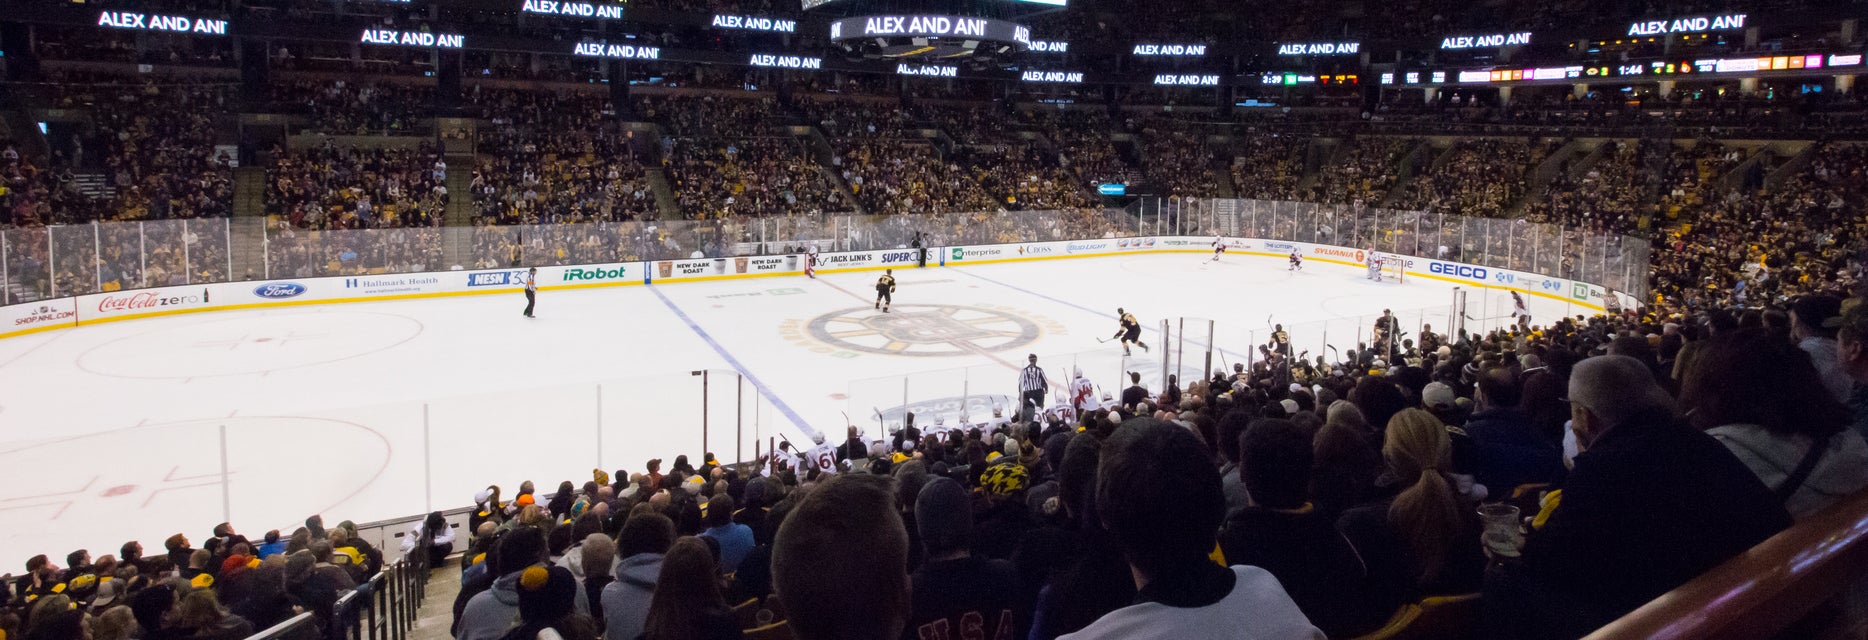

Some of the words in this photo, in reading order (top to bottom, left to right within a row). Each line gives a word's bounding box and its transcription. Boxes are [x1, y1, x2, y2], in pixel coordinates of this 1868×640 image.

[523, 0, 558, 13] ALEX
[562, 2, 593, 16] AND
[596, 5, 620, 18] ANI
[98, 11, 146, 28] ALEX
[149, 15, 190, 31] AND
[194, 18, 225, 34] ANI
[712, 15, 742, 28] ALEX
[744, 18, 772, 30] AND
[774, 20, 794, 32] ANI
[865, 17, 904, 34] ALEX
[909, 17, 950, 33] AND
[954, 18, 984, 36] ANI
[1628, 20, 1668, 36] ALEX
[1670, 18, 1708, 32] AND
[1711, 15, 1744, 29] ANI
[362, 30, 398, 44] ALEX
[401, 32, 434, 46] AND
[437, 34, 462, 48] ANI
[1014, 25, 1029, 44] ALE
[1441, 36, 1473, 49] ALEX
[1476, 34, 1504, 47] AND
[1506, 33, 1530, 45] ANI
[575, 43, 605, 56] ALEX
[607, 45, 635, 57] AND
[637, 47, 658, 59] ANI
[1049, 42, 1066, 52] ANI
[1133, 45, 1159, 55] ALEX
[1160, 45, 1184, 55] AND
[1186, 45, 1204, 55] ANI
[1279, 44, 1306, 54] ALEX
[1308, 43, 1334, 54] AND
[1336, 43, 1358, 53] ANI
[750, 54, 776, 66] ALEX
[778, 56, 800, 68] AND
[802, 58, 820, 69] ANI
[920, 65, 940, 75] AND
[941, 66, 956, 76] ANI
[1022, 71, 1043, 81] ALEX
[1045, 72, 1065, 81] AND
[1066, 73, 1082, 82] ANI
[1619, 65, 1643, 75] 1:44
[1154, 74, 1177, 84] ALEX
[1178, 75, 1199, 85] AND
[1201, 75, 1218, 85] ANI
[1263, 75, 1282, 84] 3:39
[881, 251, 933, 263] SUPERCUS
[1314, 248, 1354, 258] SYLVANIA
[563, 267, 626, 281] iRobot
[1429, 262, 1487, 279] GEICO
[363, 279, 405, 287] Hallmark
[409, 277, 438, 285] Health
[474, 273, 504, 285] NESN
[264, 284, 296, 296] Ford
[819, 450, 836, 469] 61
